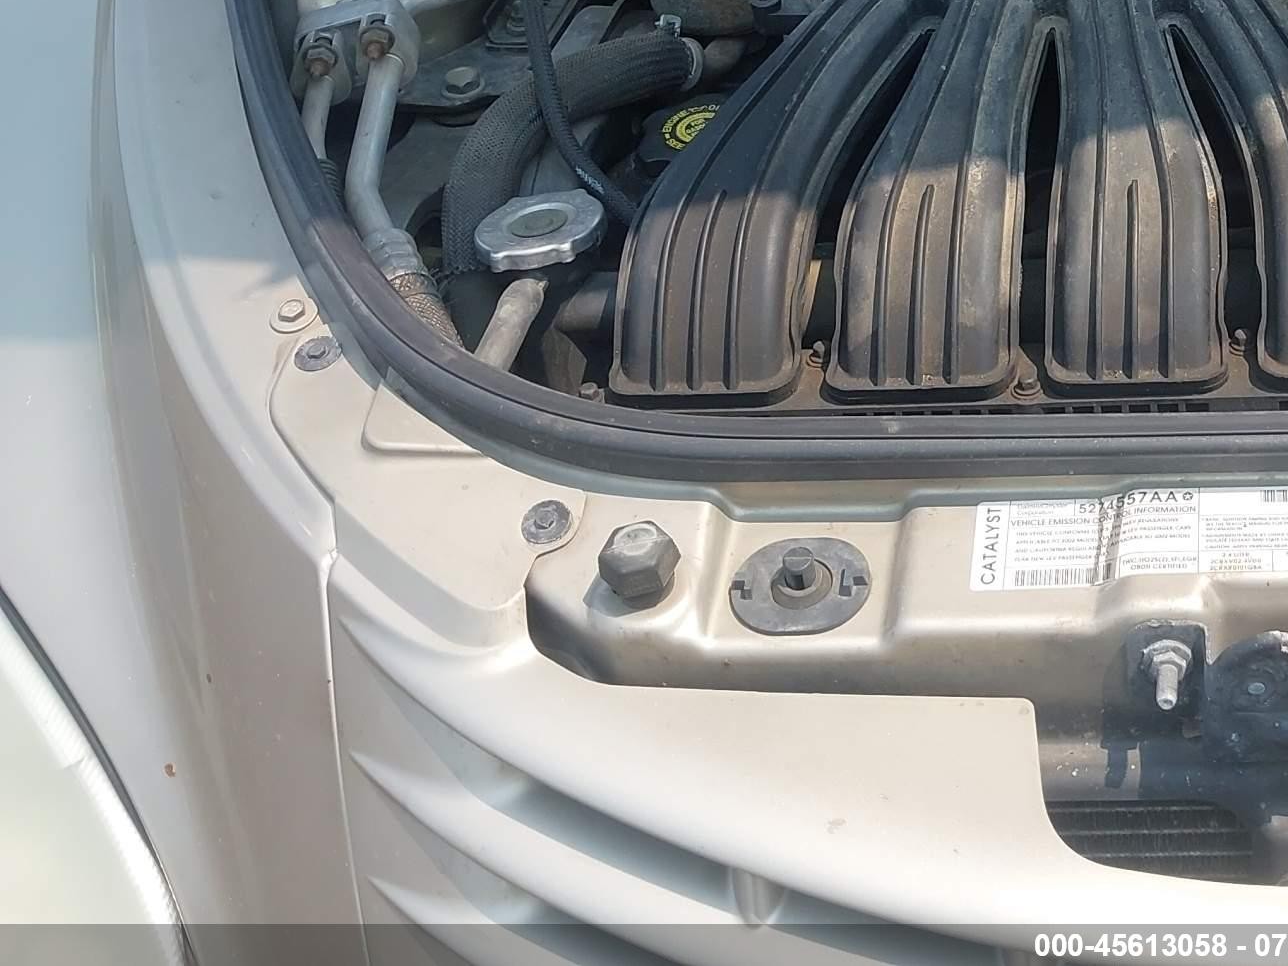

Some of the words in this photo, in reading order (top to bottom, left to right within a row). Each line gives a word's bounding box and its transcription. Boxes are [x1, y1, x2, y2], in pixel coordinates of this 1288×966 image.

[1010, 519, 1046, 527] VEHICLE
[1048, 516, 1090, 525] EMISSION
[1092, 509, 1132, 523] CONTROL
[1134, 506, 1197, 514] INFORMATION
[980, 507, 1002, 585] CATALYST
